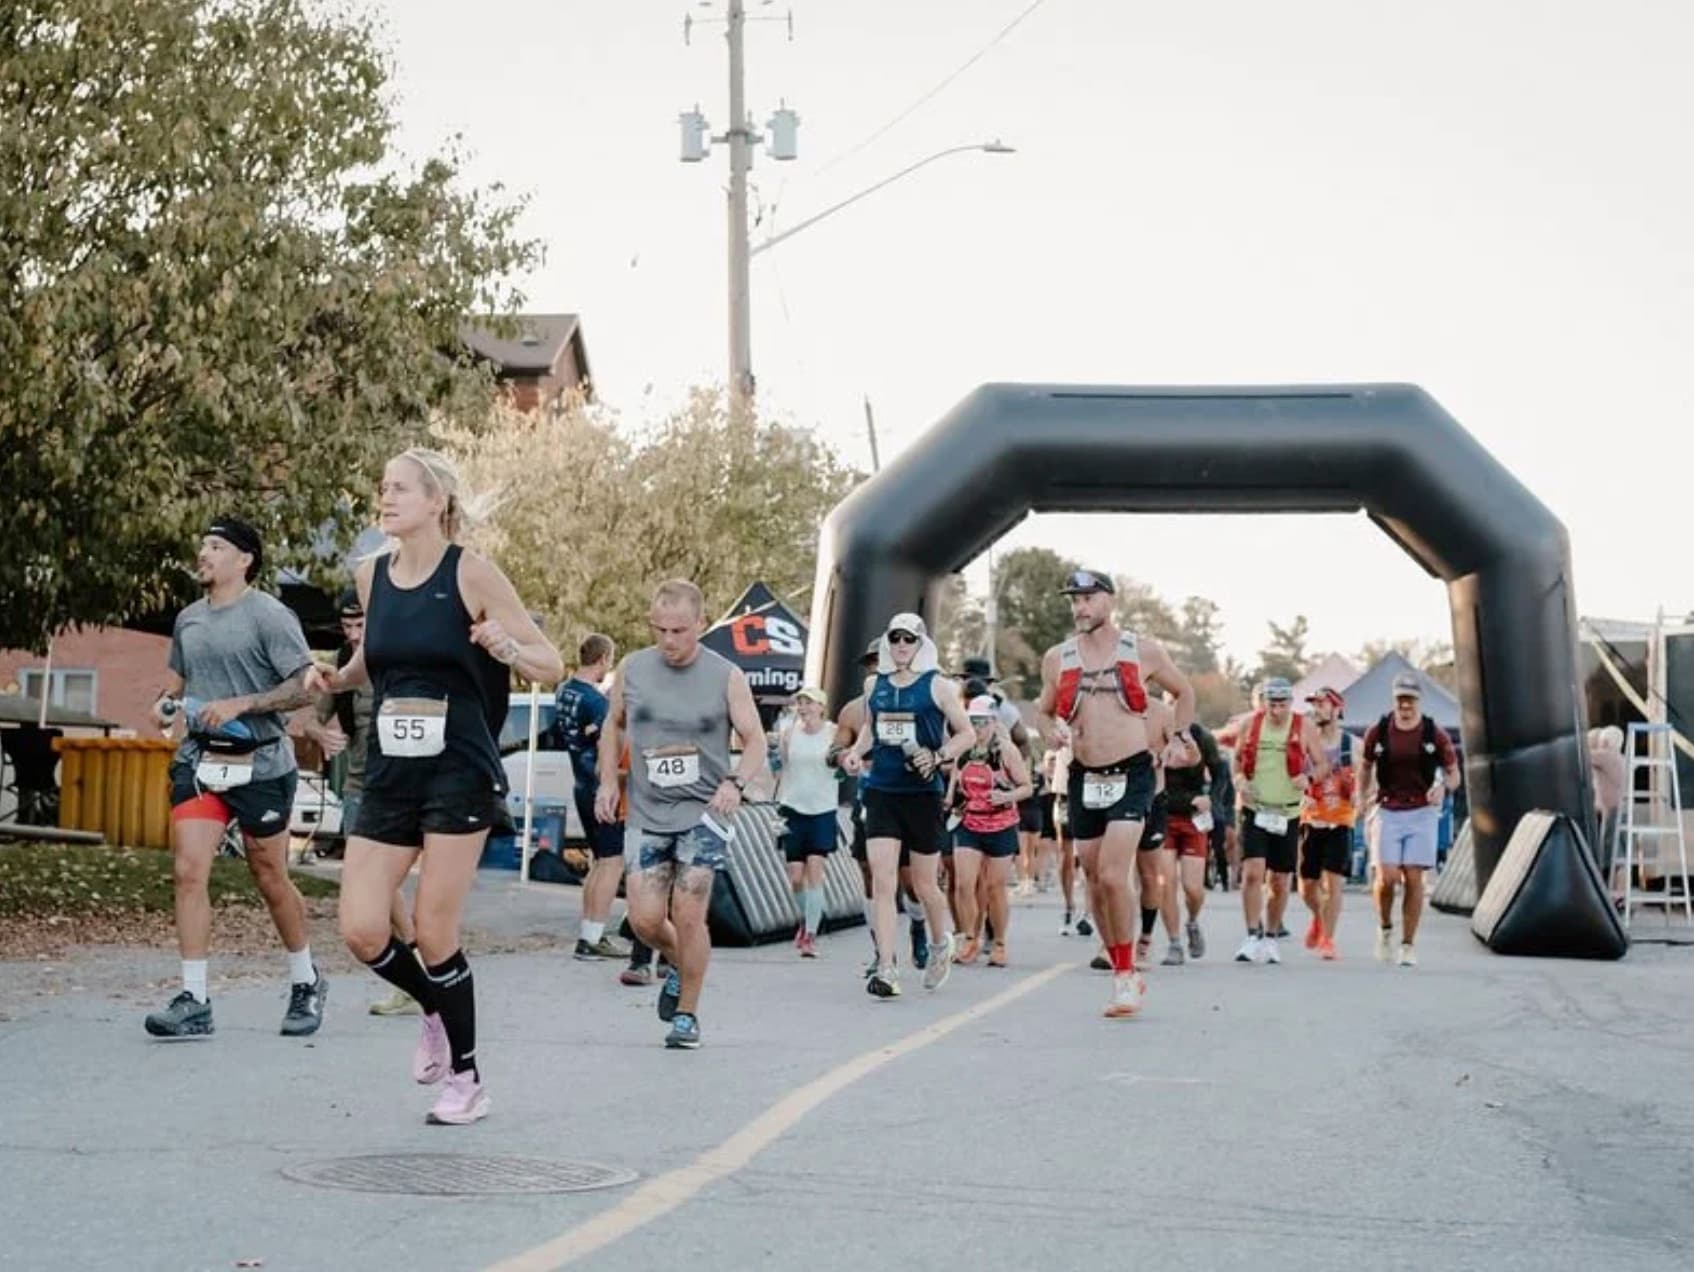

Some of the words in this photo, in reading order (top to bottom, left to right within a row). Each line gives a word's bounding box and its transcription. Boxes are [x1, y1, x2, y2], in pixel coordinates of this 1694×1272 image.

[731, 614, 804, 655] CS
[745, 667, 803, 691] ming.
[393, 719, 425, 740] 55
[656, 758, 685, 775] 48
